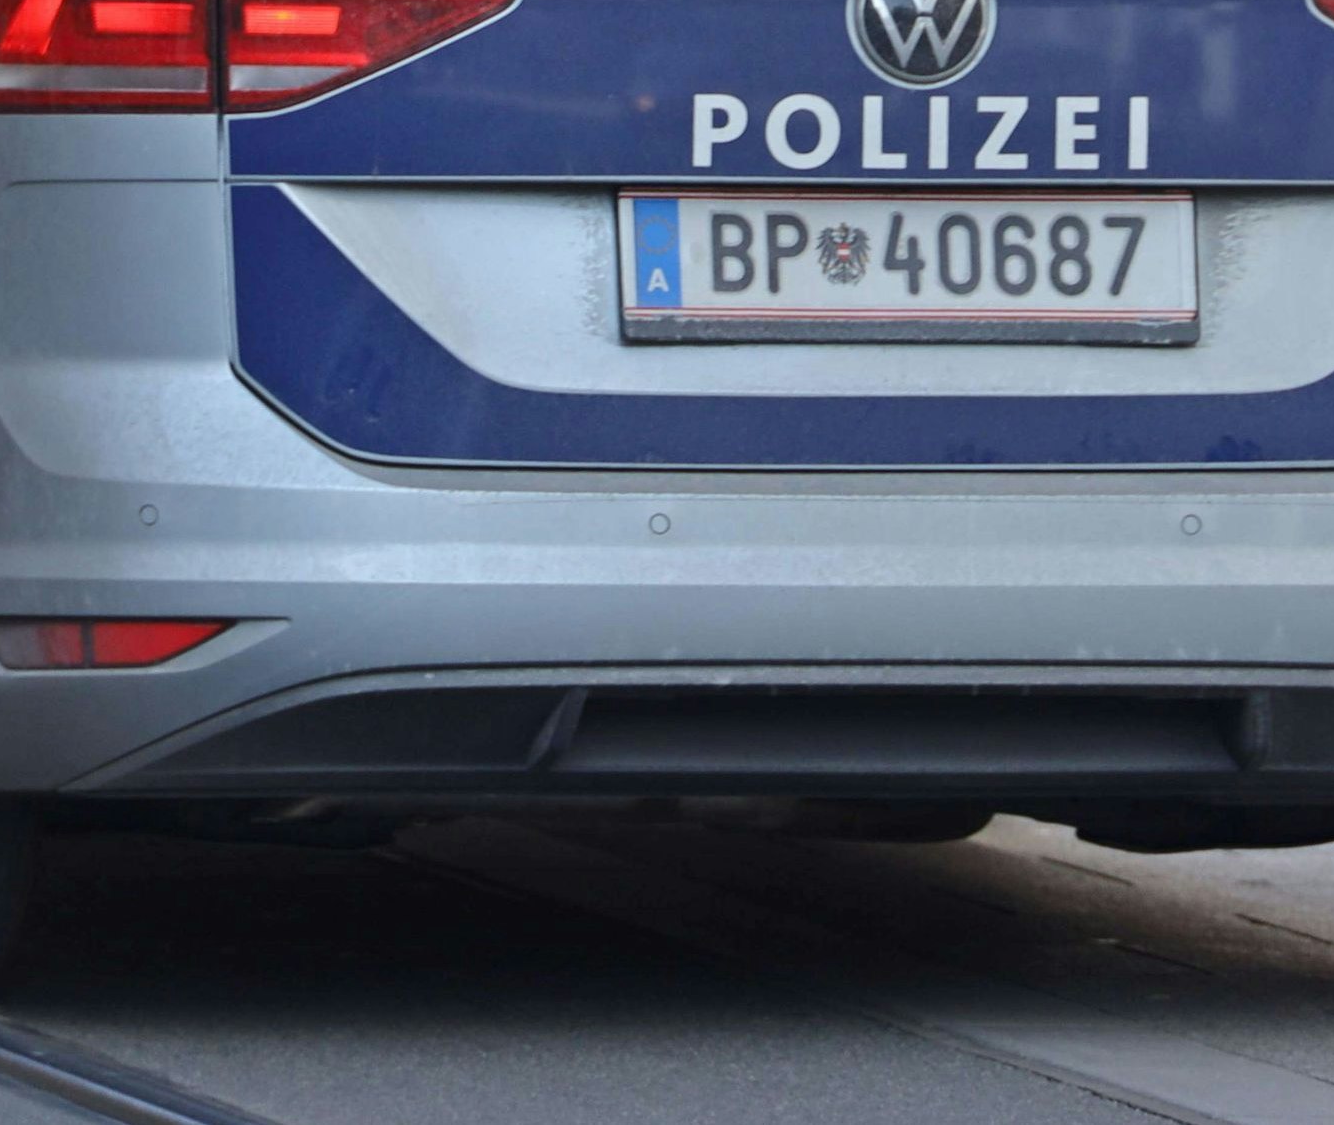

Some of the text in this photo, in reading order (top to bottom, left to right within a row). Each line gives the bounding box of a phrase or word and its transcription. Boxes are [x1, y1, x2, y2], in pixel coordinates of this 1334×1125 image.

[692, 93, 1150, 170] POLIZEI
[646, 268, 670, 293] A
[711, 211, 1146, 297] BP 40687
